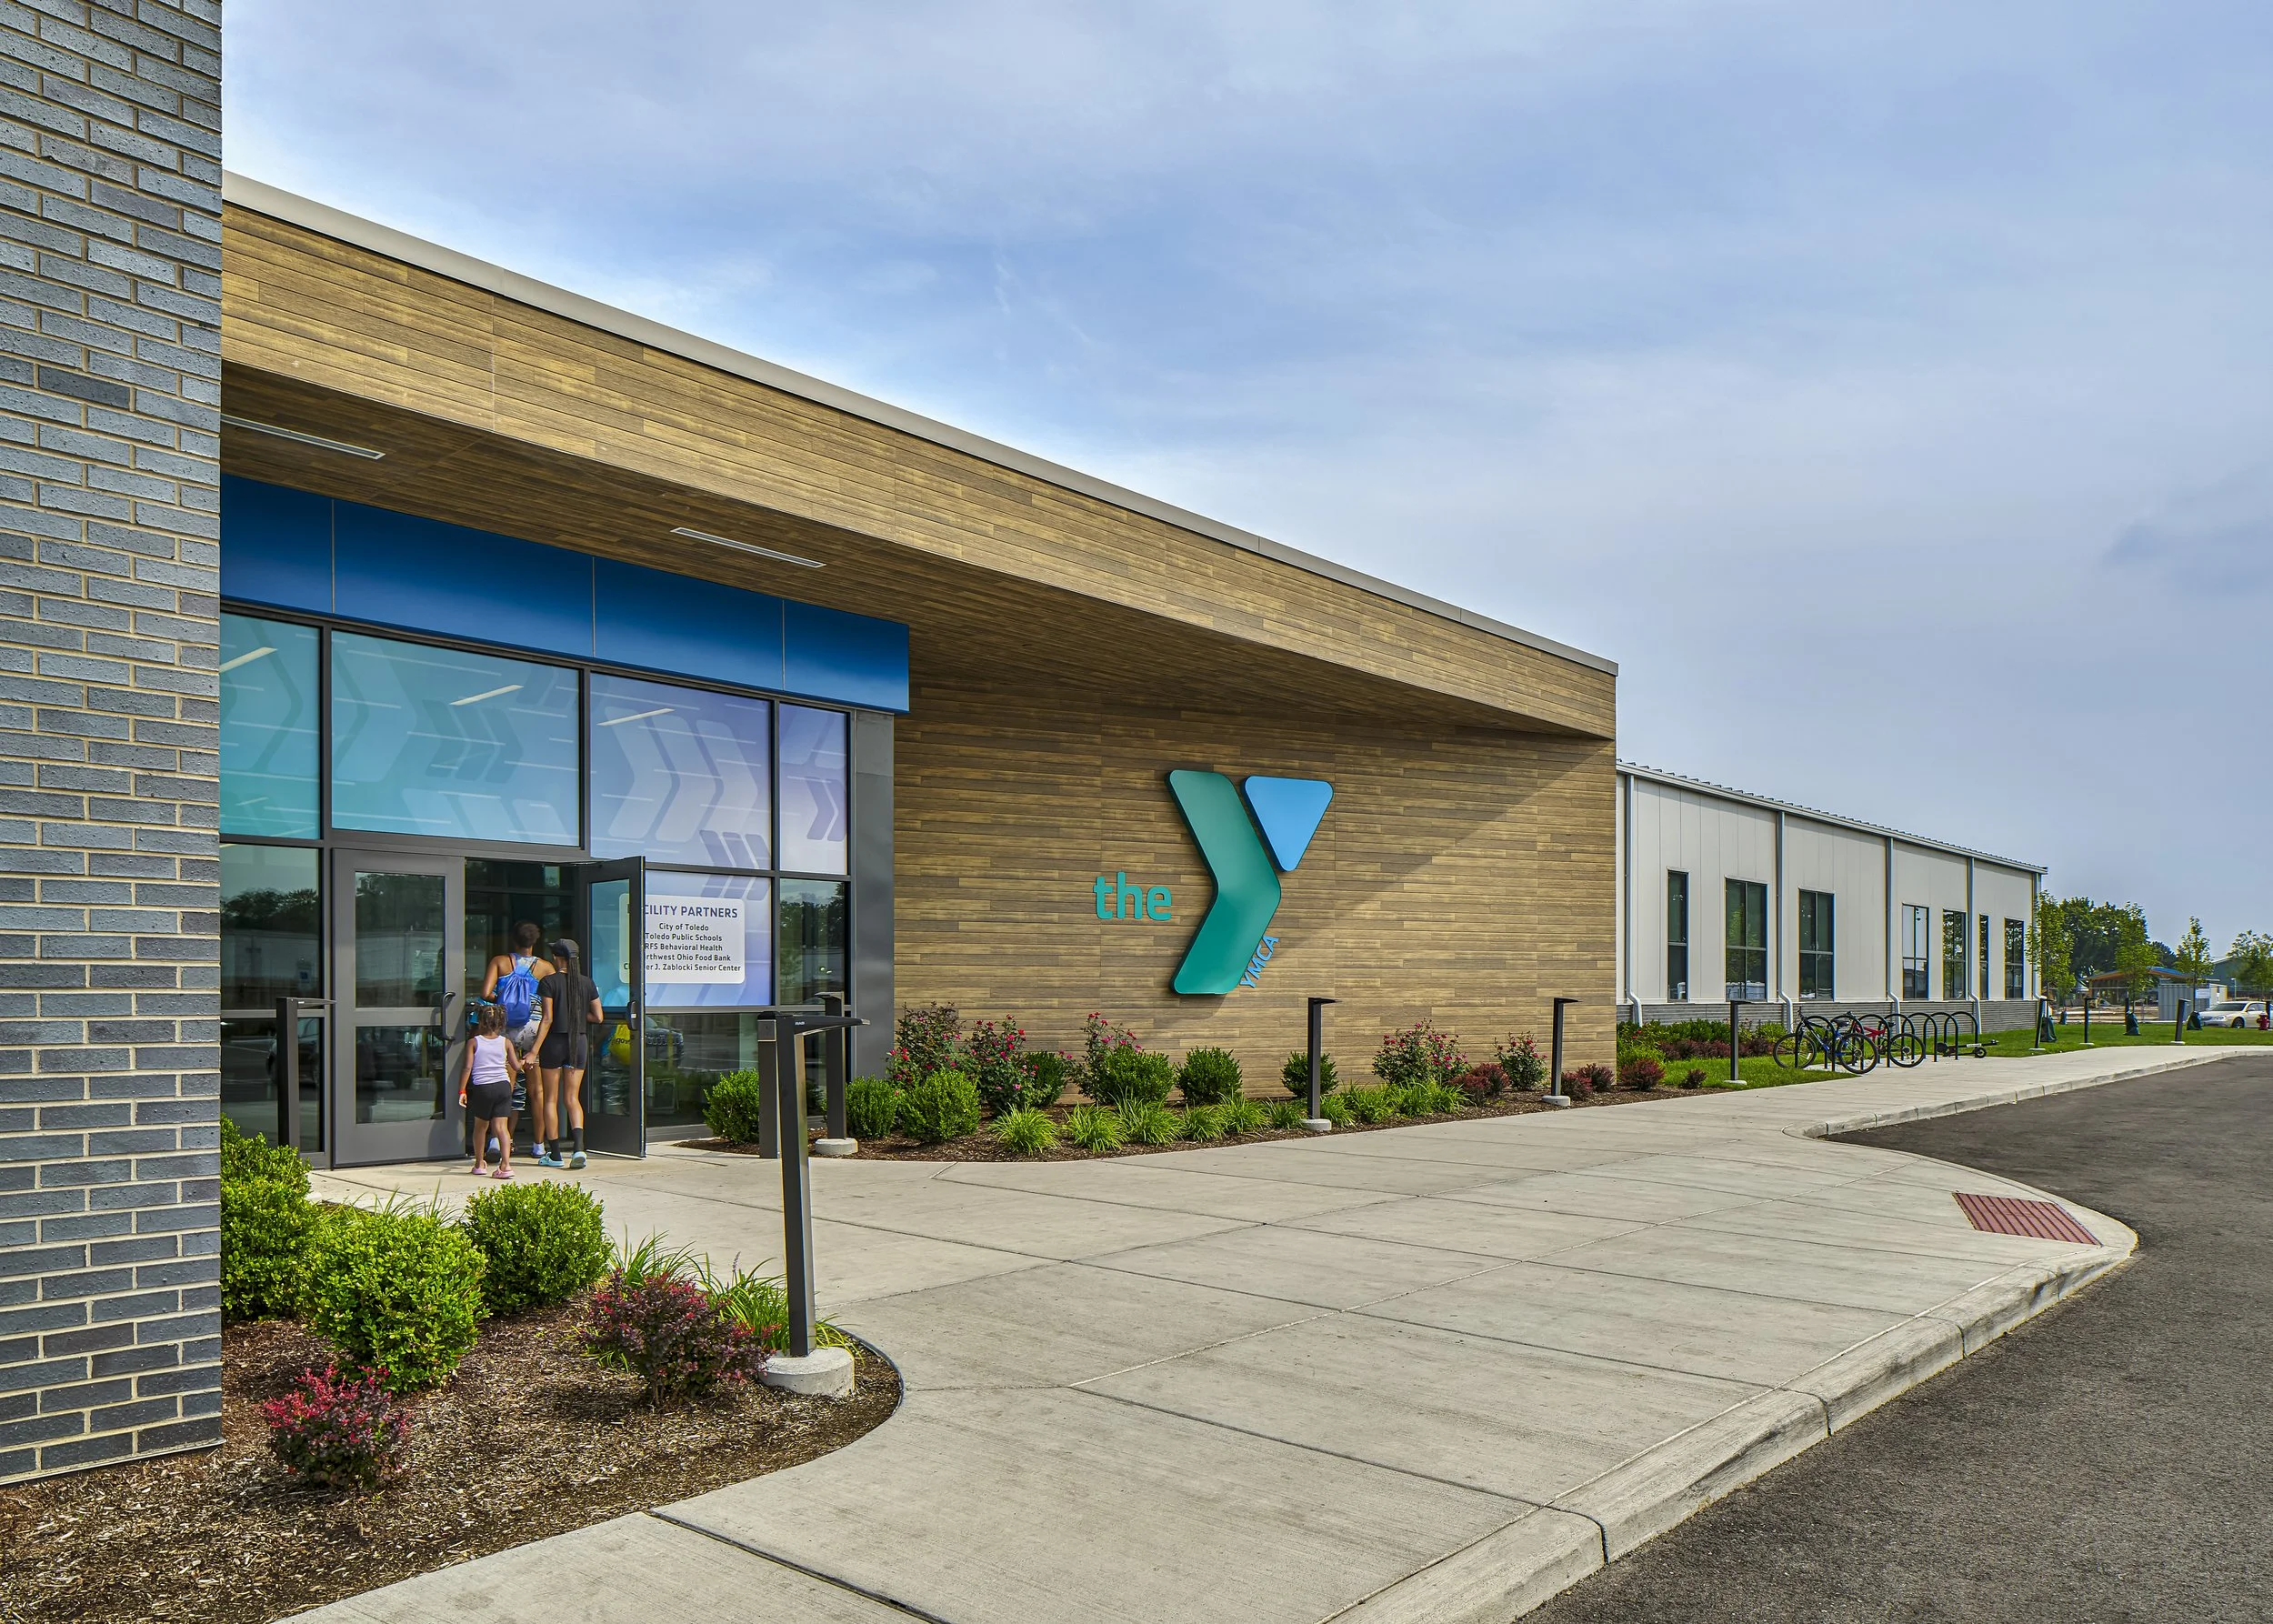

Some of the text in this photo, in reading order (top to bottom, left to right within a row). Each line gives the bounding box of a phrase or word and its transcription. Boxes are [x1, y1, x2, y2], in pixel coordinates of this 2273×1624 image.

[1093, 870, 1172, 921] the
[681, 906, 738, 918] PARTNERS
[659, 923, 673, 932] City
[645, 932, 723, 942] Toledo Public Schools
[660, 943, 698, 951] Behavioral
[676, 953, 694, 961] Ohio
[714, 954, 731, 962] Bank
[1239, 936, 1279, 988] YMCA
[663, 963, 693, 971] Zablocki
[718, 964, 742, 972] Center
